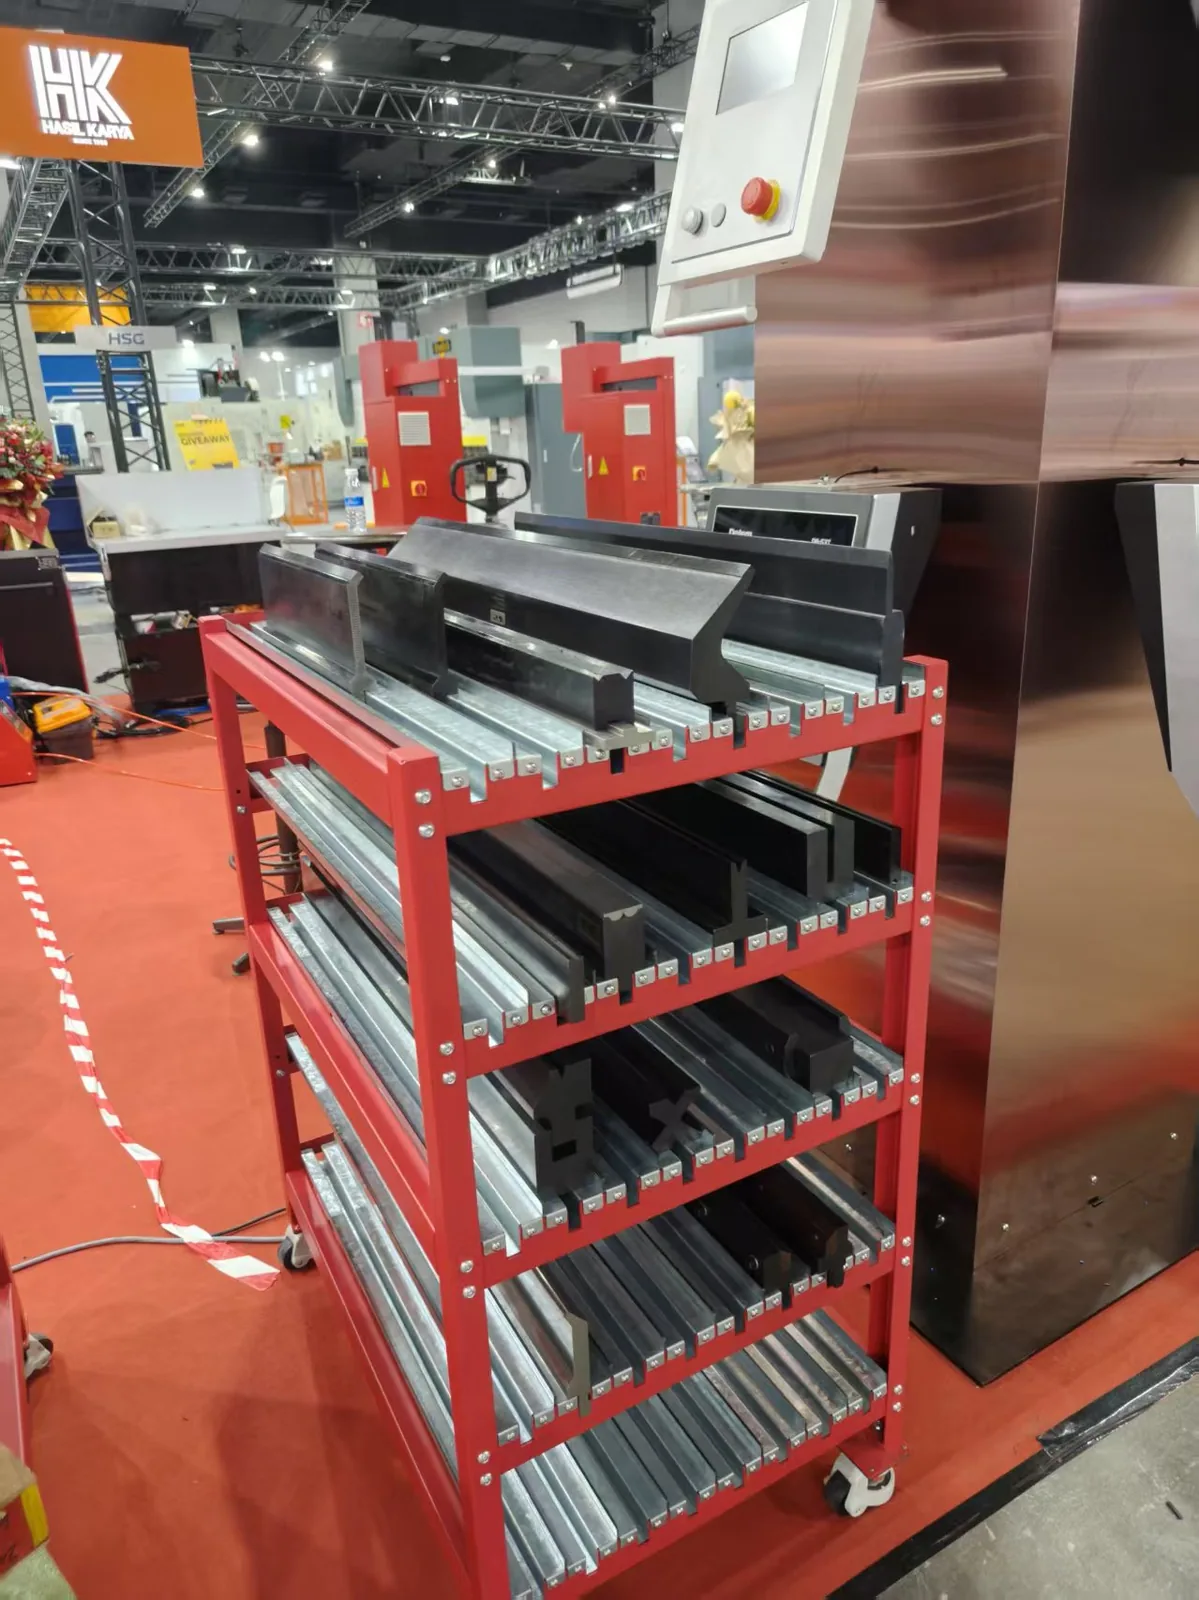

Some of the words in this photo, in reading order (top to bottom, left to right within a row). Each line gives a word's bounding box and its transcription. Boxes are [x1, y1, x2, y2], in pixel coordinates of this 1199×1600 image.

[28, 44, 133, 125] HK
[41, 119, 86, 136] HASIL
[86, 122, 135, 140] KARYA
[108, 332, 145, 345] HSG
[180, 434, 231, 446] GIVEAWAY
